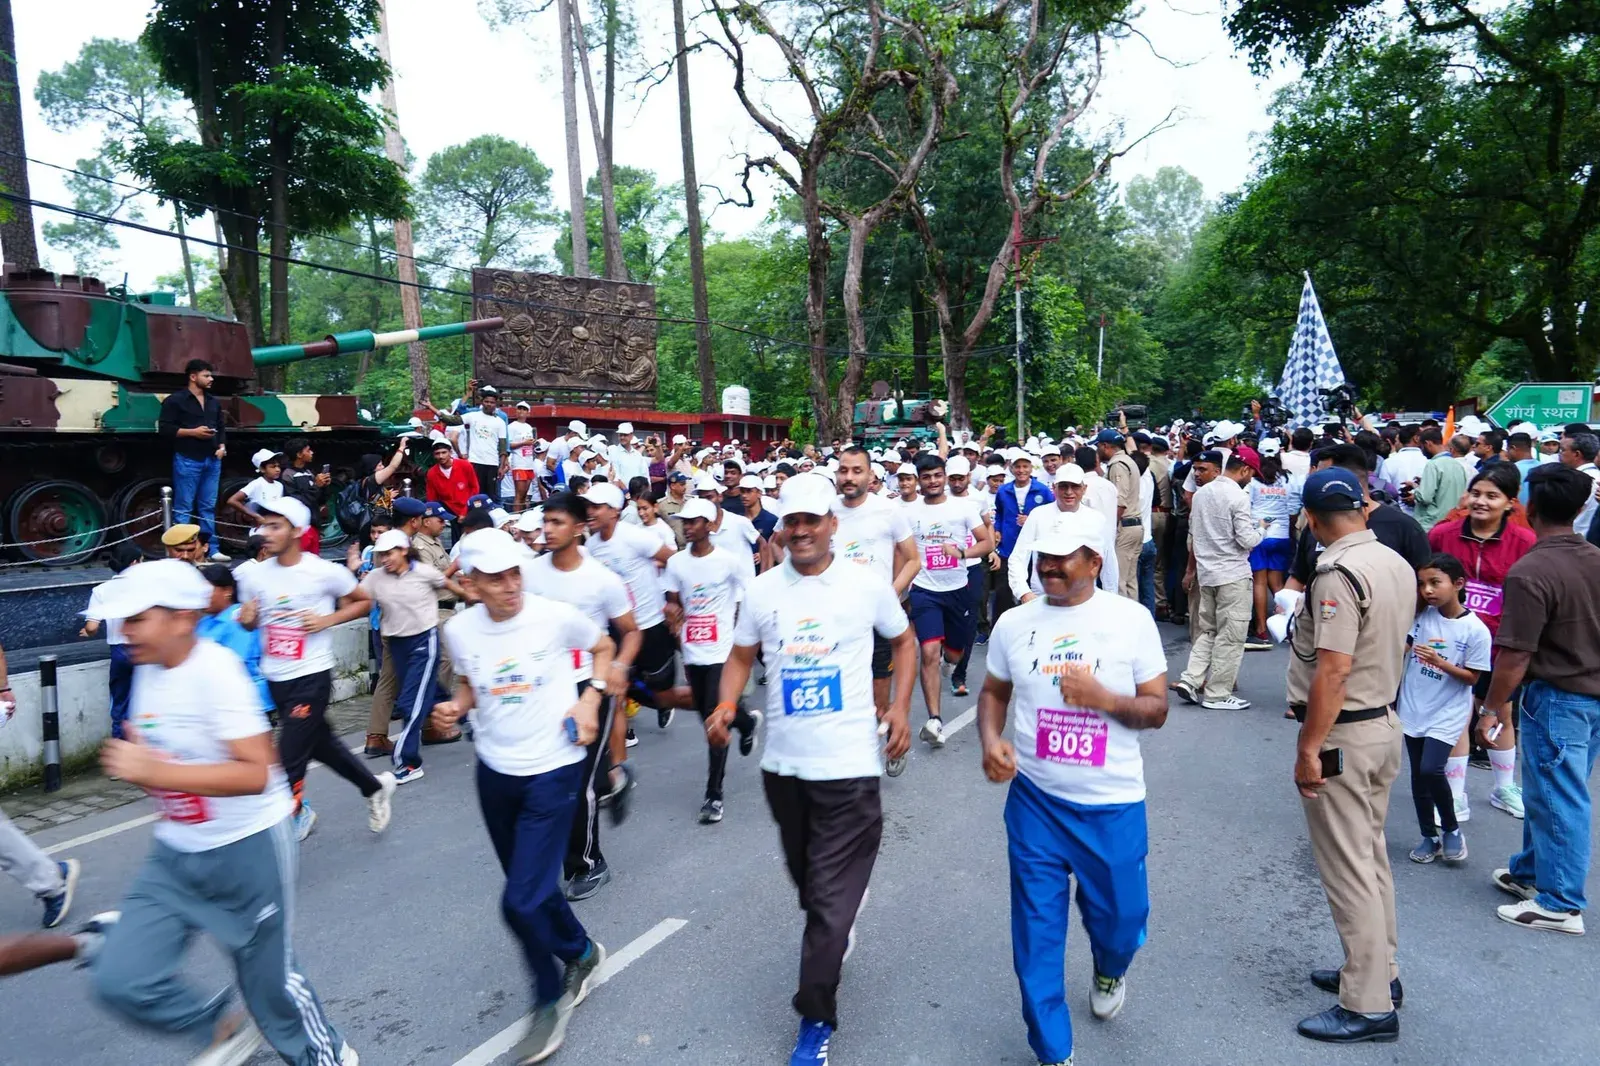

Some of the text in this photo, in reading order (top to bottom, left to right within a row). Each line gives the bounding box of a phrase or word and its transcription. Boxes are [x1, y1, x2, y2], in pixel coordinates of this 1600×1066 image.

[1504, 403, 1579, 419] शौर्य स्थल
[931, 555, 952, 566] 897
[790, 685, 832, 711] 651
[1048, 729, 1094, 758] 903
